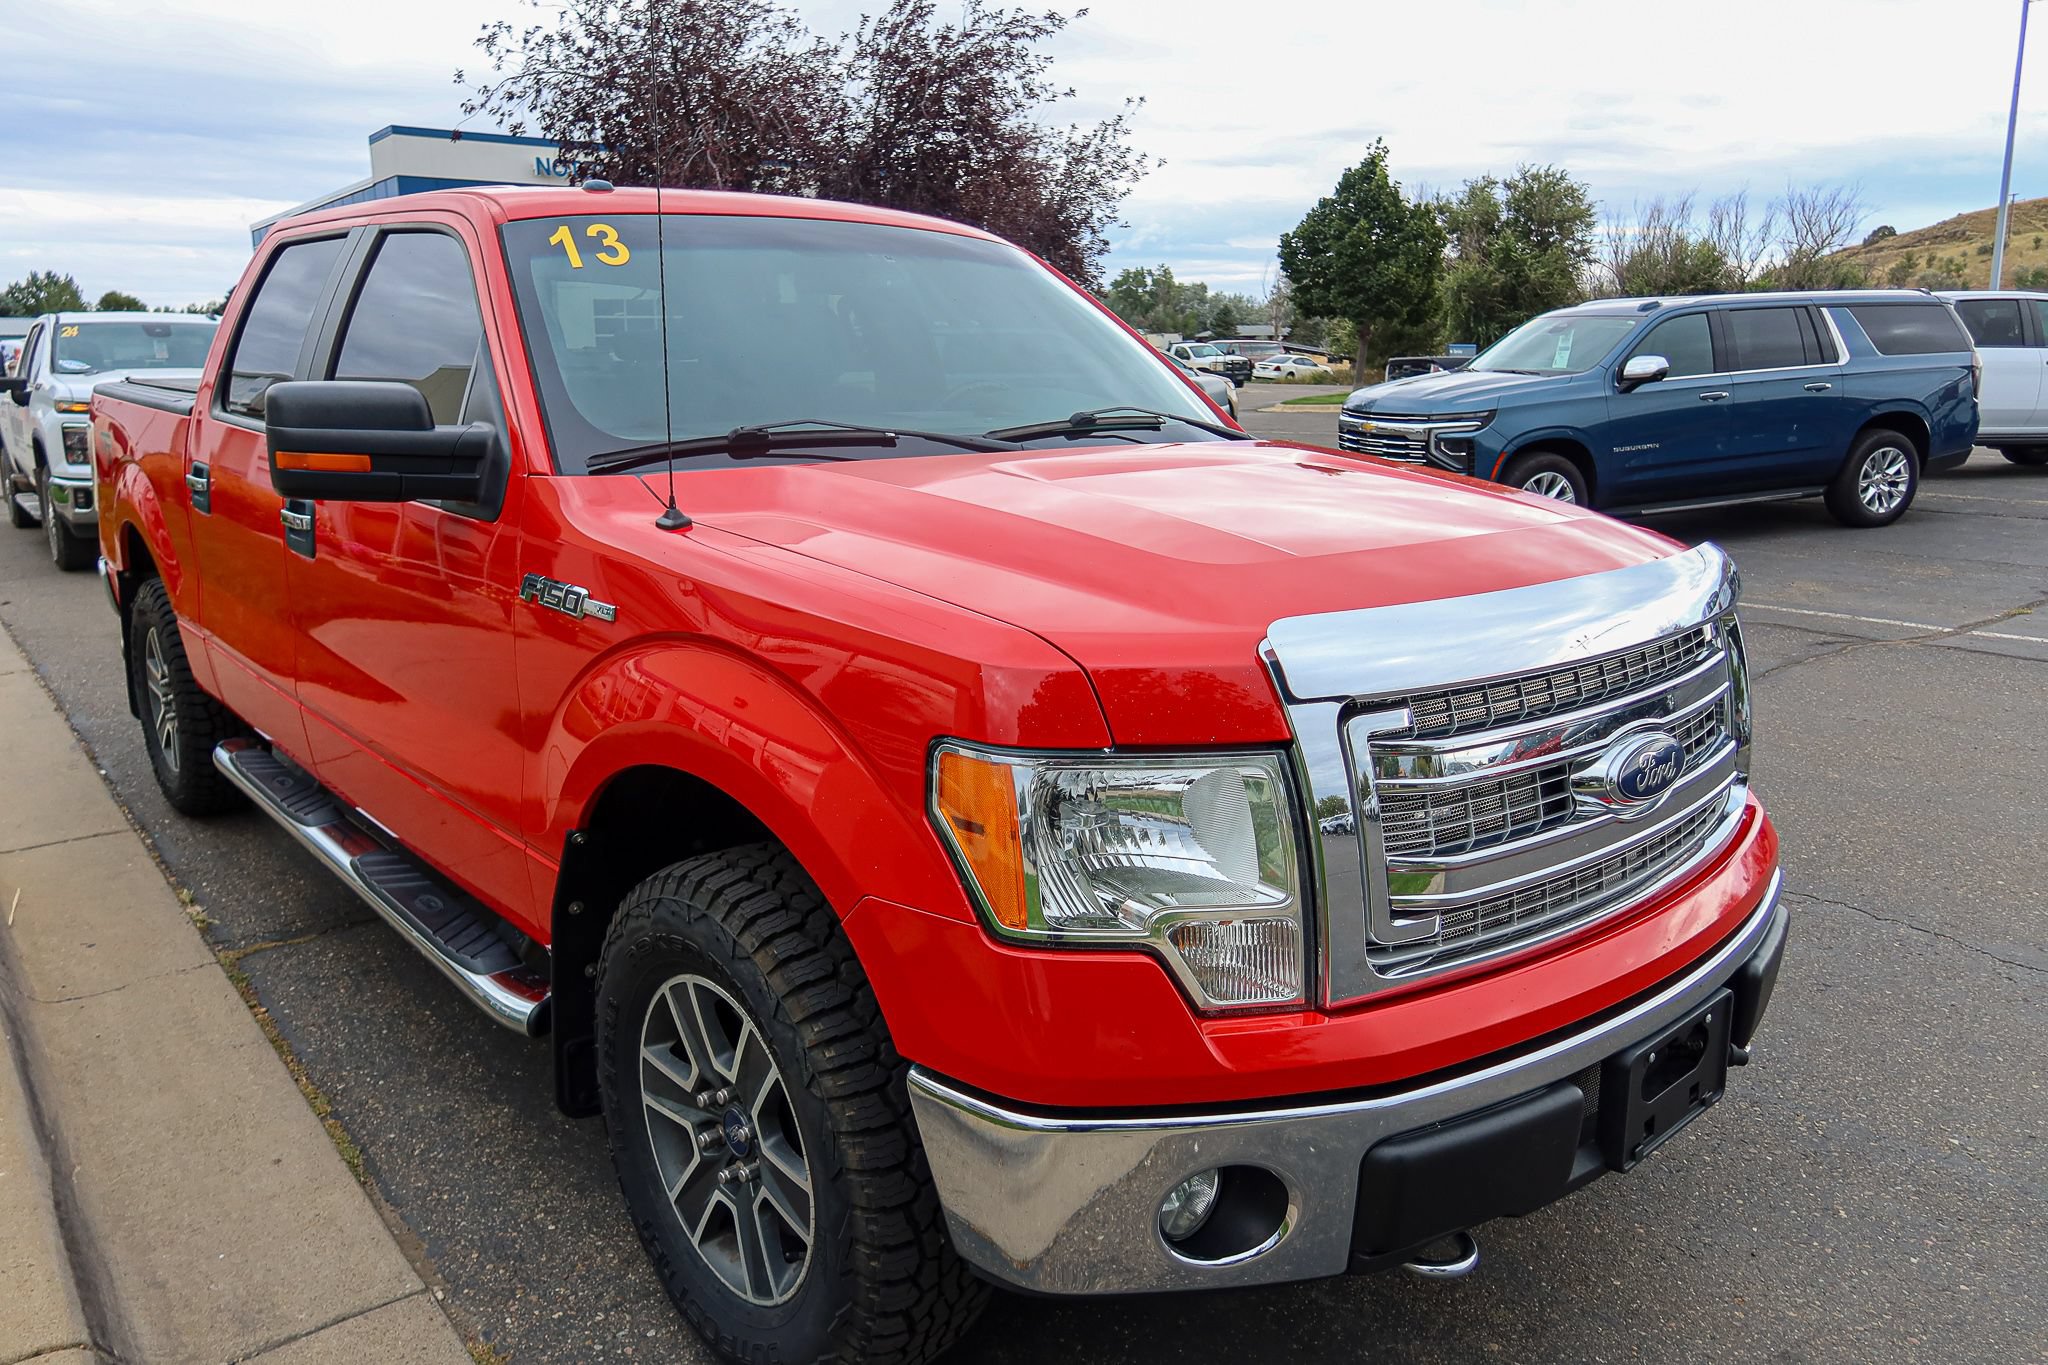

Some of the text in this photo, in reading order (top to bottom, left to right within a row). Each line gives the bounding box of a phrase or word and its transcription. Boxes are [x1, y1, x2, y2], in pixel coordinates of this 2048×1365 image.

[548, 223, 630, 269] 13
[1613, 443, 1660, 452] SUBURBAN
[1636, 747, 1677, 792] Ford
